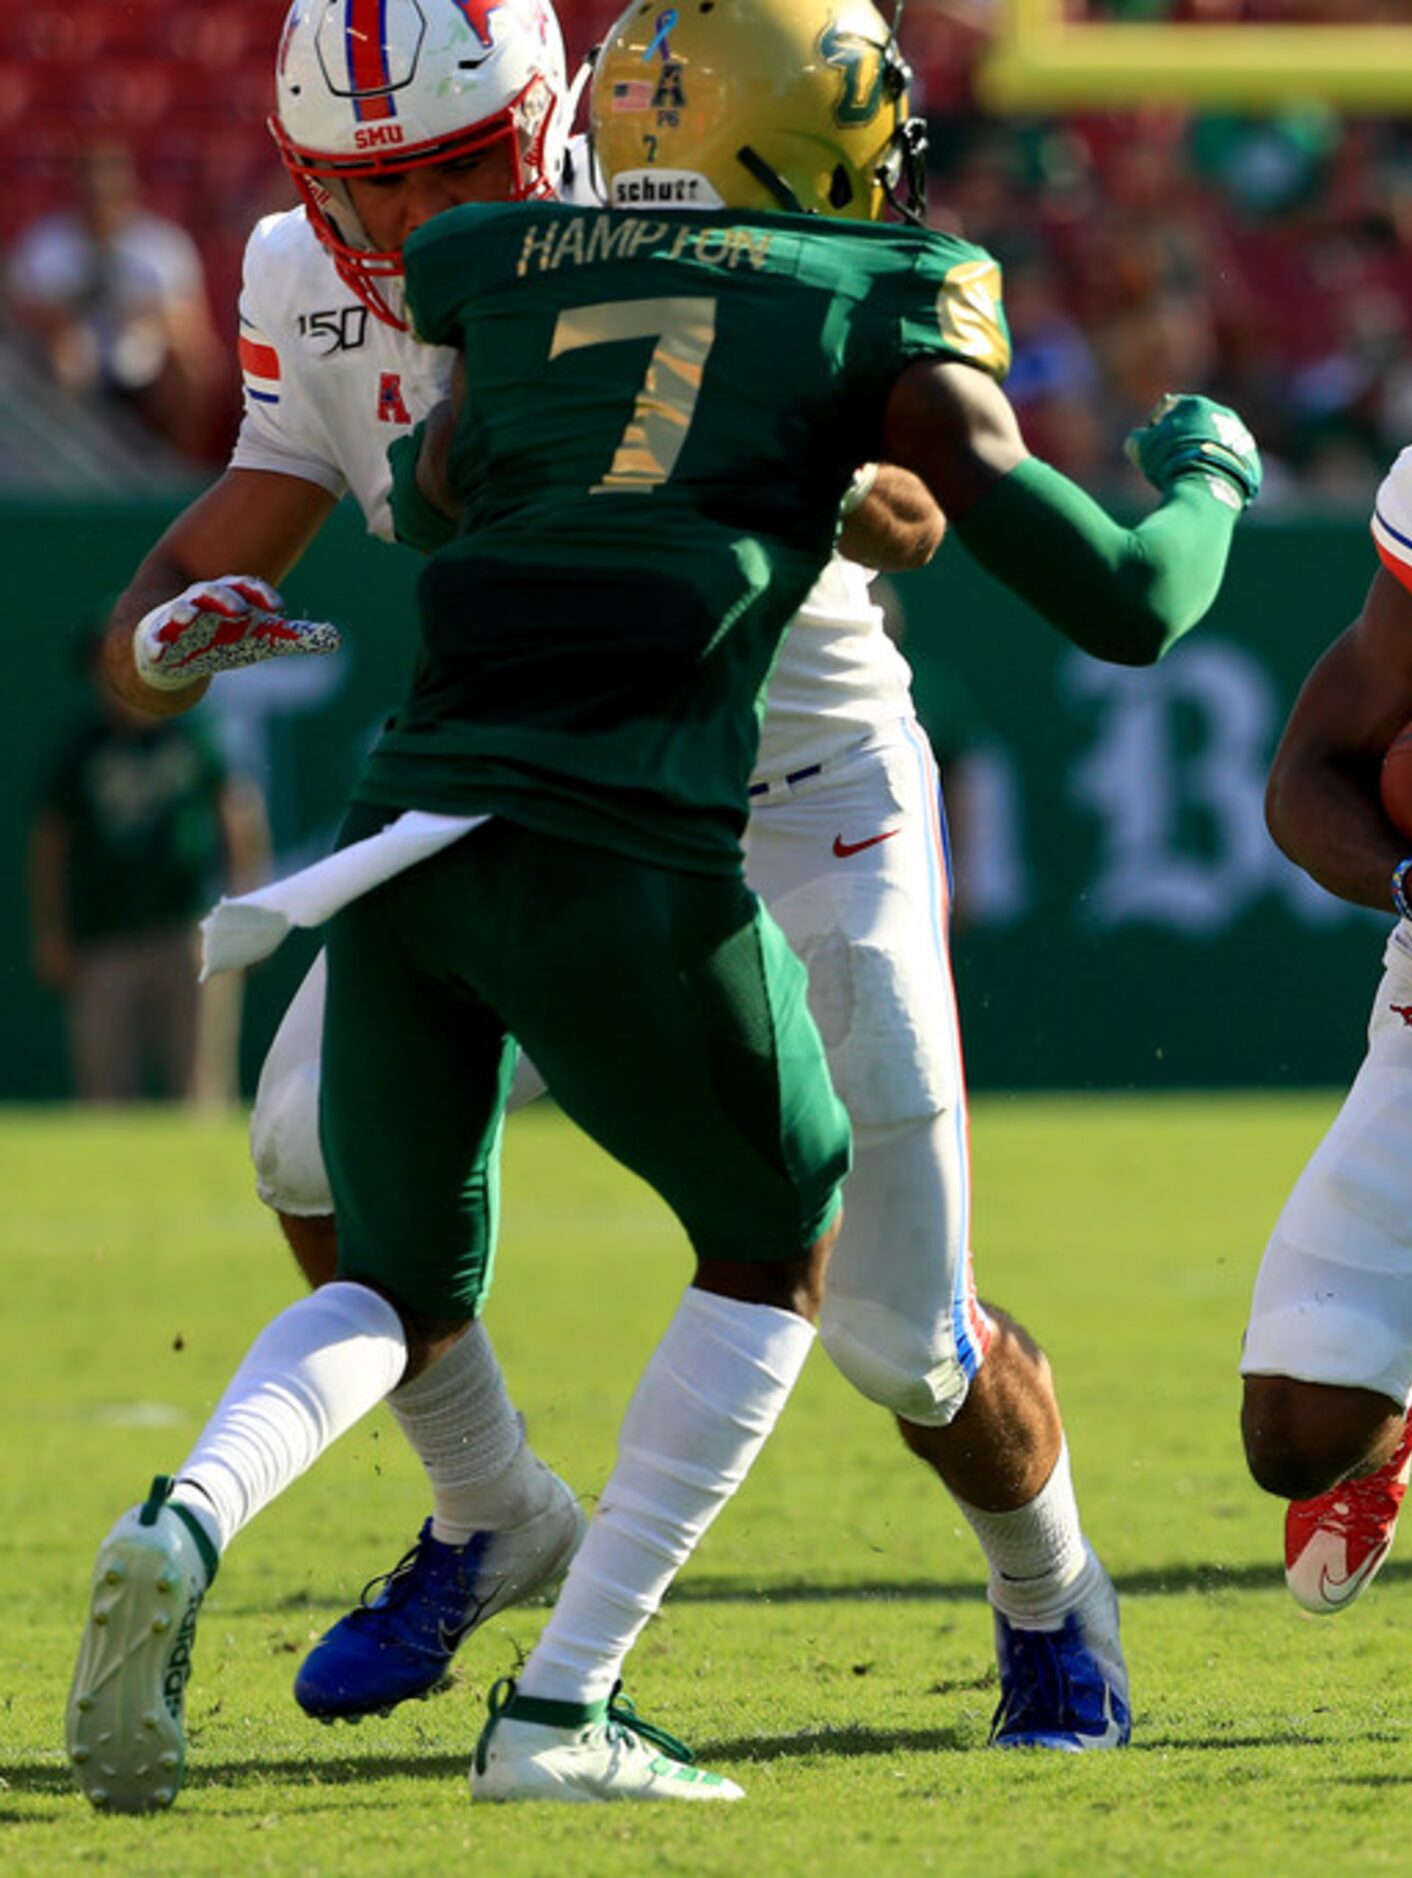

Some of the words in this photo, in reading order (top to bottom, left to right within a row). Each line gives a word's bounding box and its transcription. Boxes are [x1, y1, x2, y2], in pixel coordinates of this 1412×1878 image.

[354, 124, 404, 150] SMU
[642, 134, 658, 163] 7
[516, 214, 773, 277] HAMPTON
[298, 304, 369, 357] 150
[376, 371, 412, 425] A
[548, 297, 717, 495] 7
